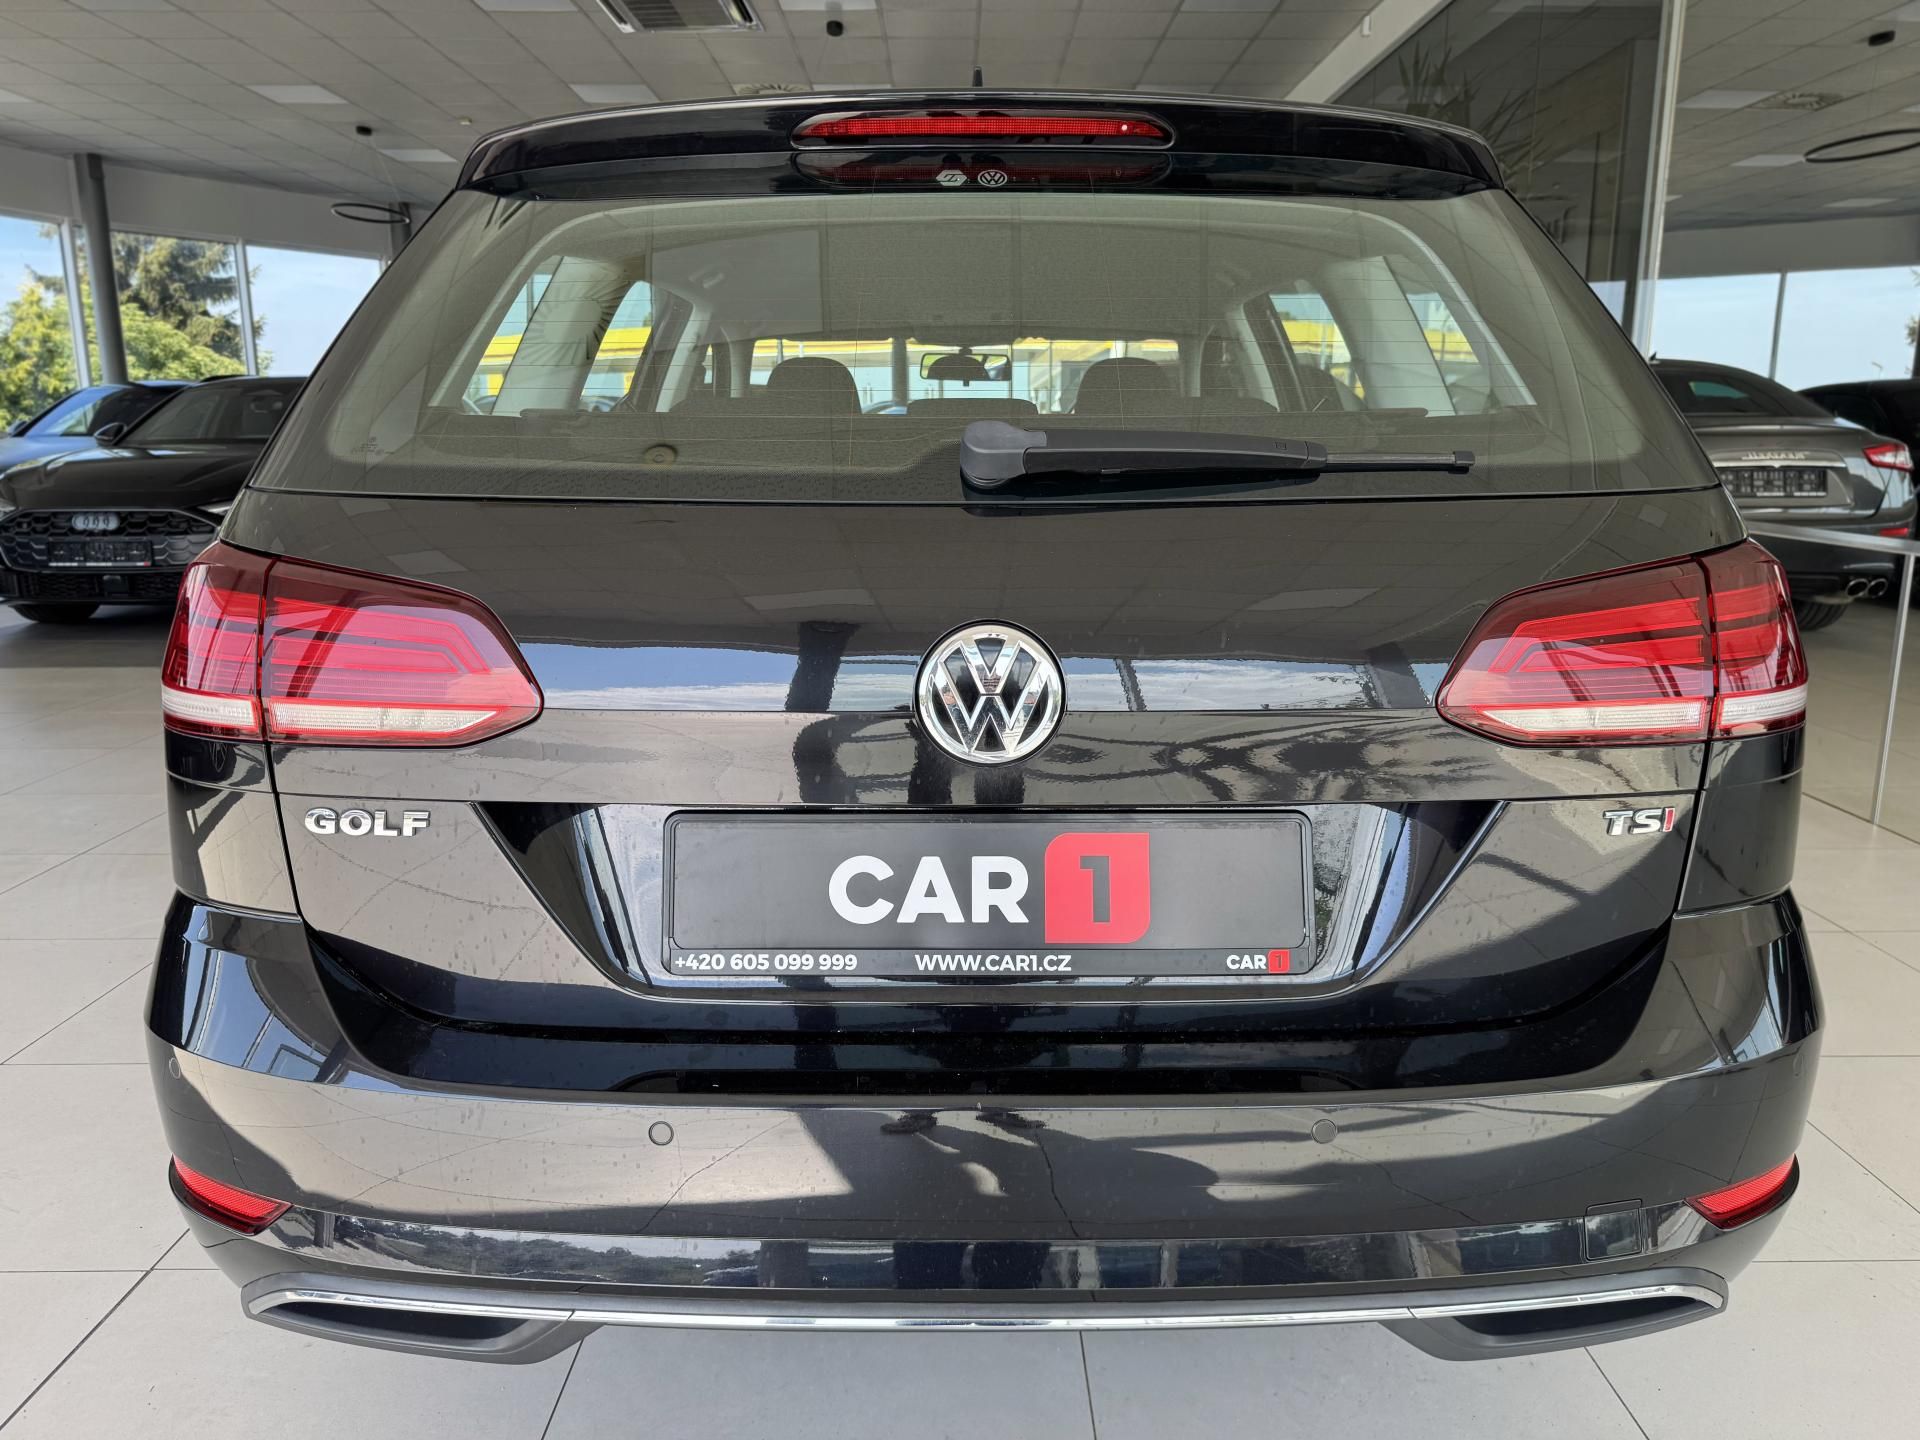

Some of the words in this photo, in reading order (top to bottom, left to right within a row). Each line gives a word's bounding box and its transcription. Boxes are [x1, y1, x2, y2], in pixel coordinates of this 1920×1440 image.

[304, 807, 431, 837] GOLF
[1602, 806, 1676, 836] TSI
[674, 953, 726, 971] +420
[729, 953, 770, 971] 605
[774, 953, 815, 971] 099
[818, 953, 858, 971] 999
[914, 954, 1072, 972] WWW.CAR1.CZ
